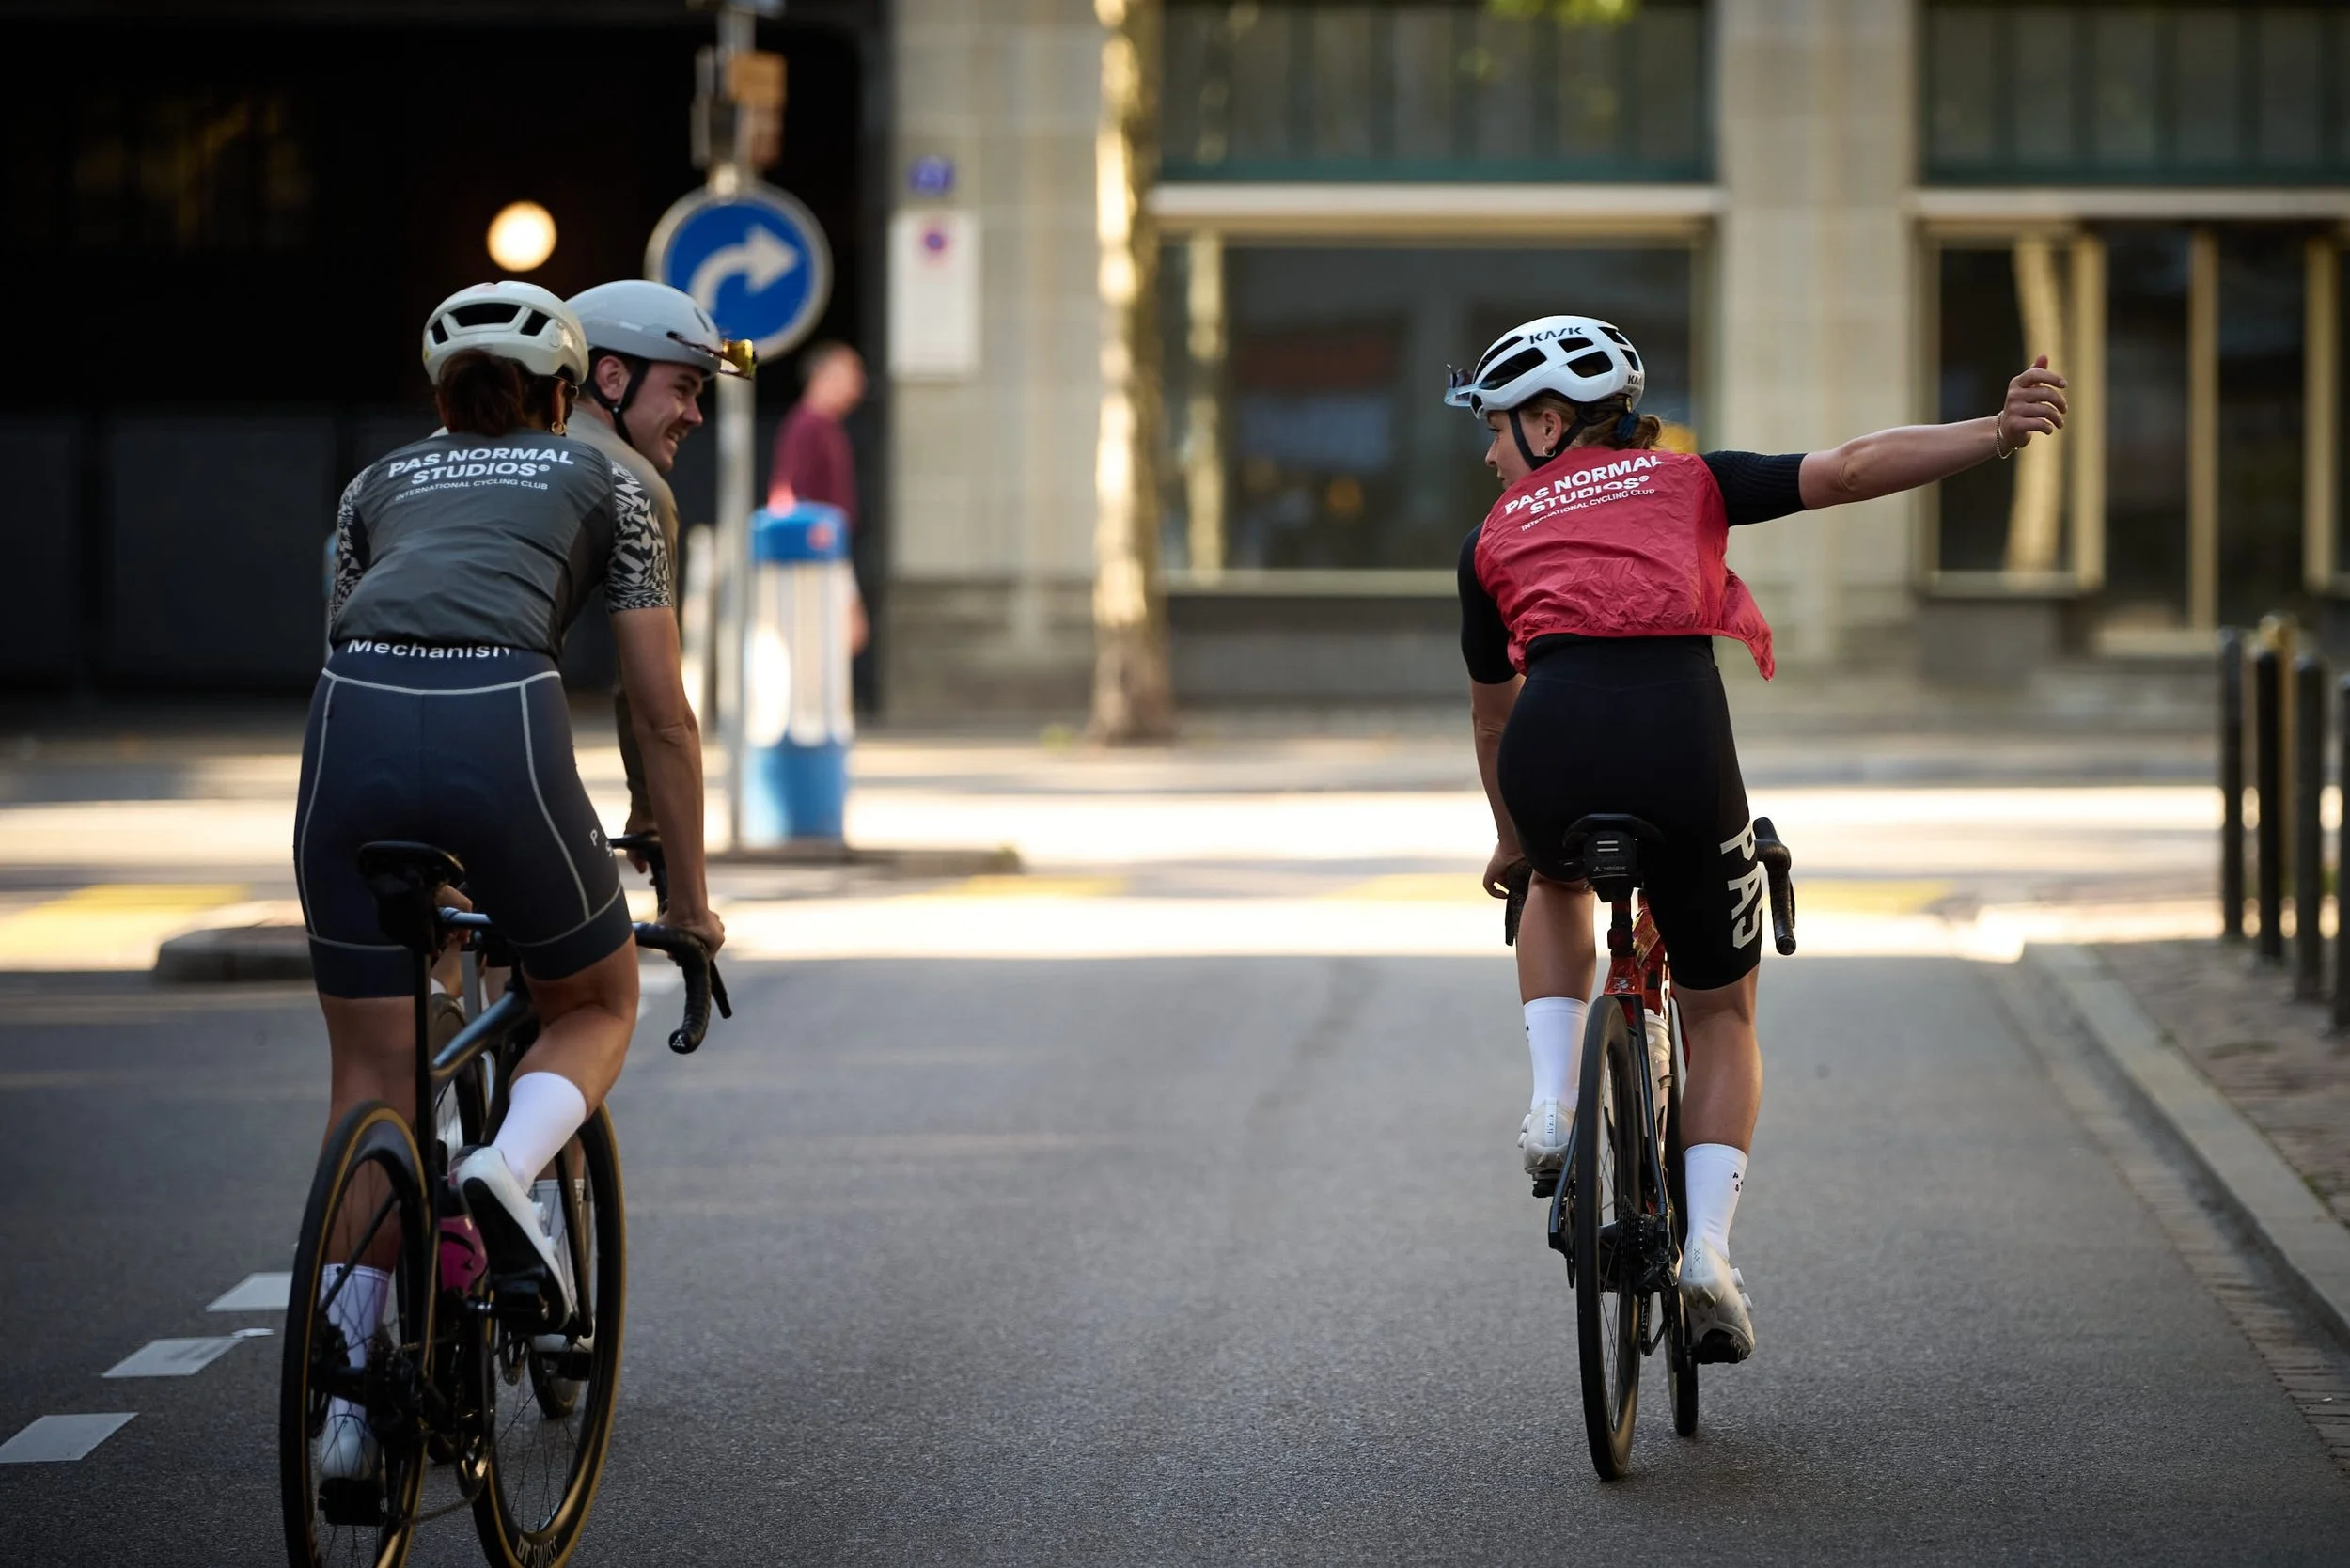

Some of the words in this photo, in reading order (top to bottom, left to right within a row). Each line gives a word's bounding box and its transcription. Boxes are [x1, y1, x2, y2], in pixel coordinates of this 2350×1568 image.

[1530, 327, 1583, 344] KASK
[388, 453, 441, 478] PAS
[447, 447, 574, 465] NORMAL
[395, 481, 470, 502] INTERNATIONAL
[473, 478, 518, 487] CYCLING
[520, 480, 549, 490] CLUB
[1505, 487, 1550, 515] PAS
[1554, 456, 1666, 494] NORMAL
[1590, 490, 1629, 506] CYCLING
[1630, 488, 1655, 496] CLUB
[1719, 821, 1763, 949] PAS
